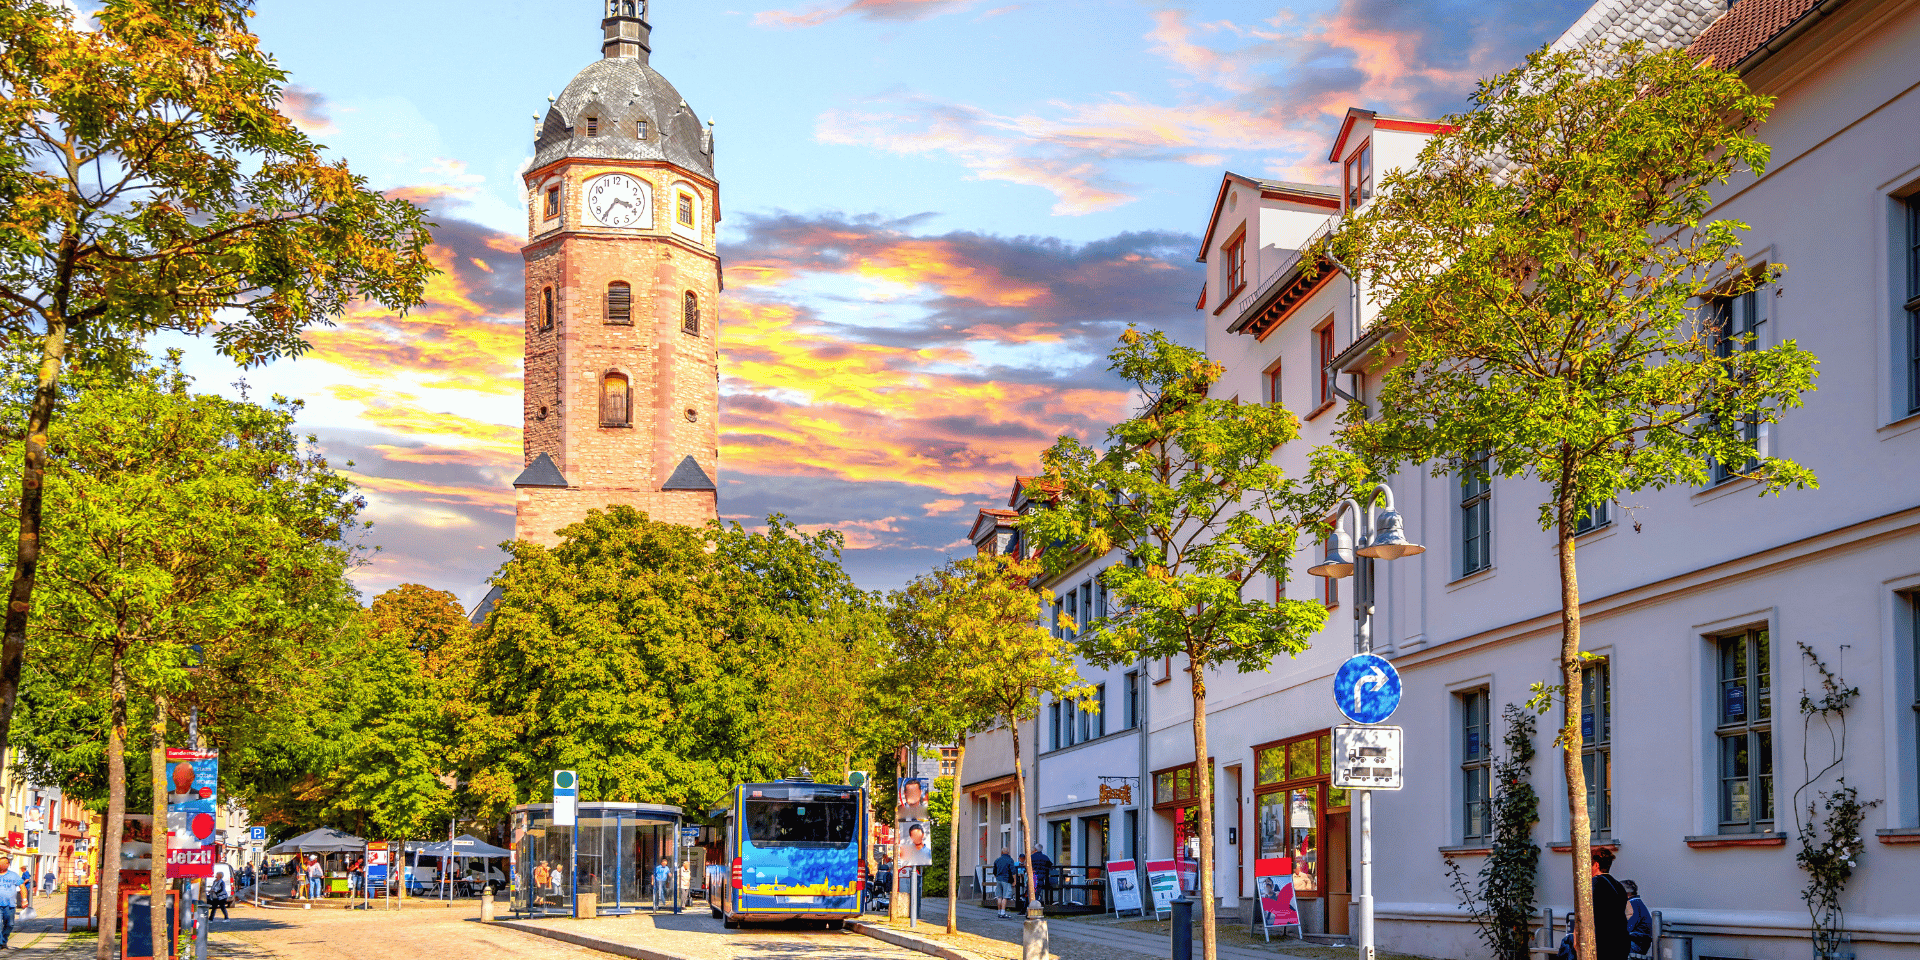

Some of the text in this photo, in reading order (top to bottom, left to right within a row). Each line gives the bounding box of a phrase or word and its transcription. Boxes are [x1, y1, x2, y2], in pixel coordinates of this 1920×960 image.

[604, 179, 609, 187] 11
[613, 176, 621, 185] 12
[596, 186, 603, 194] 10
[633, 187, 638, 196] 2
[592, 196, 598, 204] 9
[635, 198, 641, 206] 3
[596, 206, 601, 214] 8
[631, 208, 637, 216] 4
[614, 217, 619, 225] 6
[624, 214, 630, 223] 5
[254, 828, 262, 839] P
[168, 850, 211, 864] Jetzt!
